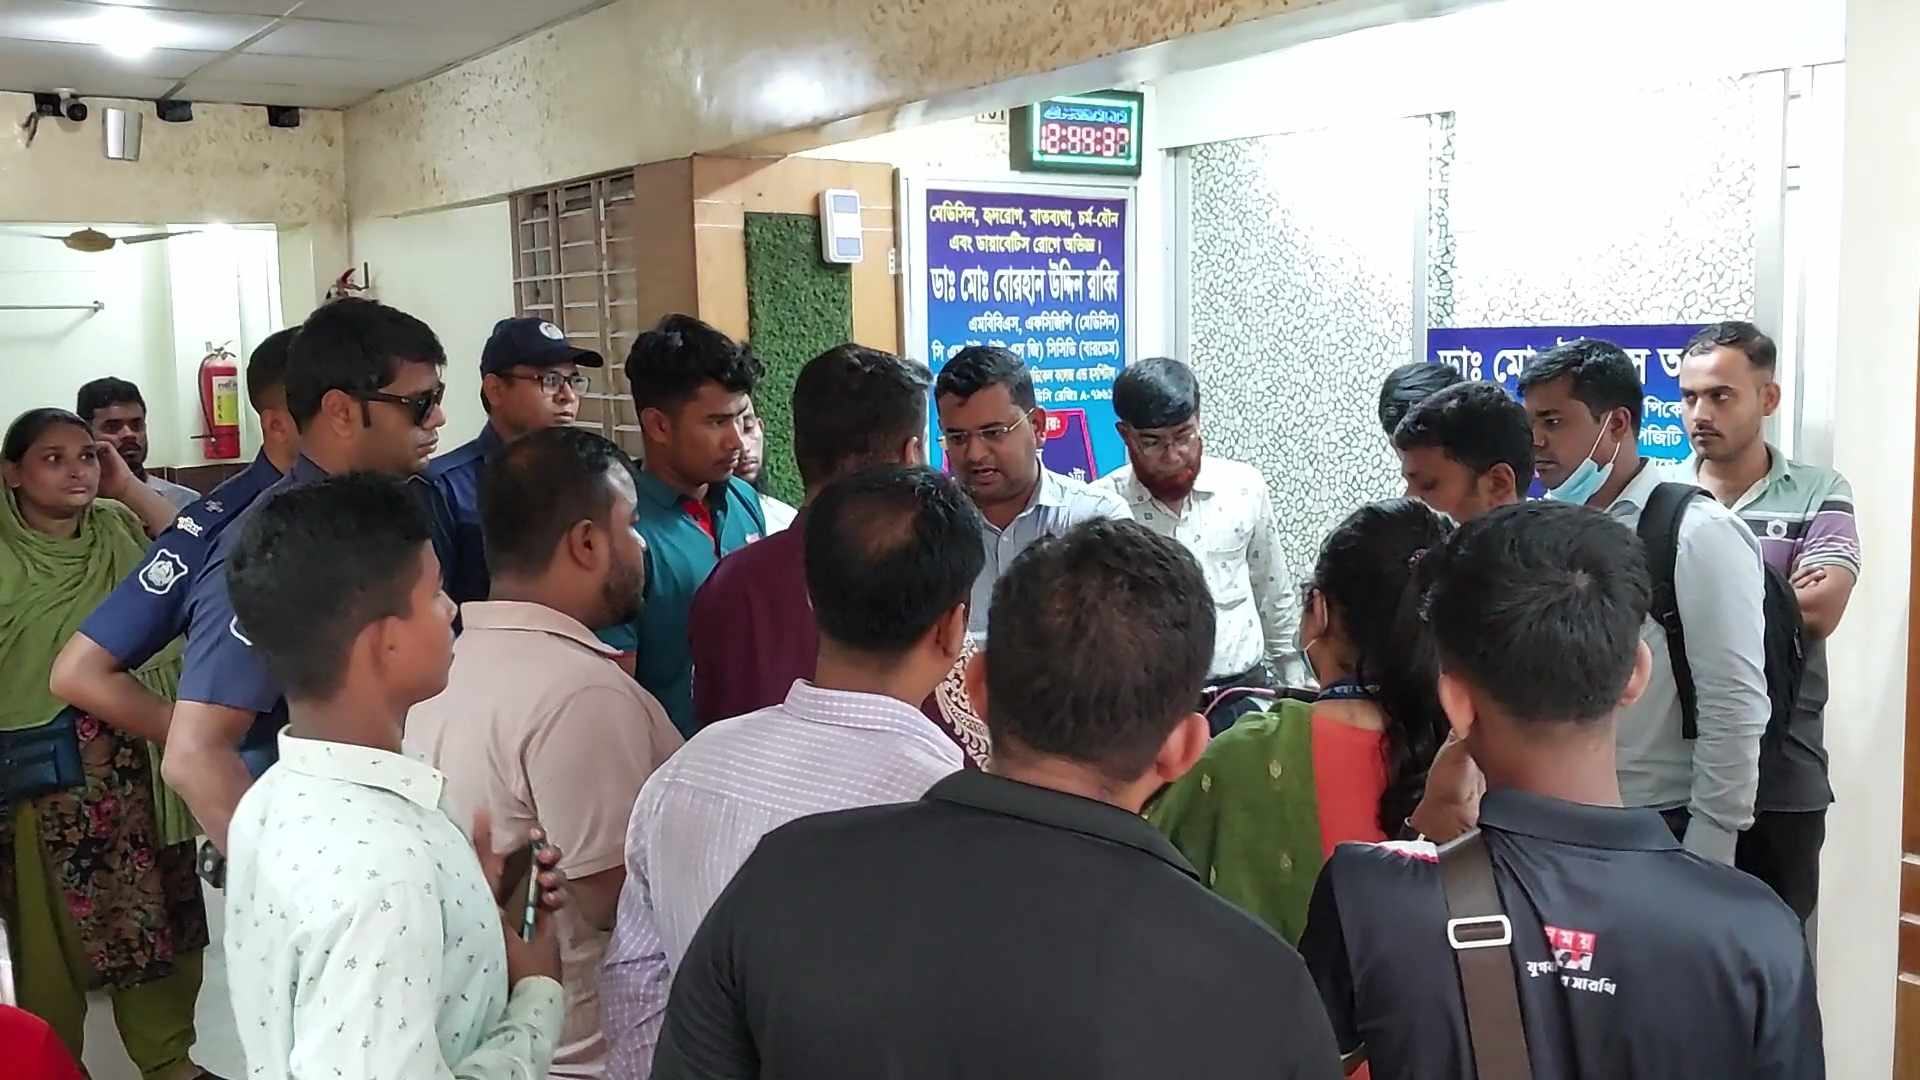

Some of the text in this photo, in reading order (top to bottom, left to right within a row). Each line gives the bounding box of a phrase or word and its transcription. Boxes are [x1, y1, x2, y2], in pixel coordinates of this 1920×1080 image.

[949, 234, 974, 253] এবং
[1033, 236, 1061, 254] রোগে
[929, 264, 956, 301] ডাঃ
[960, 264, 990, 303] মোঃ
[994, 265, 1046, 307] বোরহান
[1048, 257, 1085, 303] উদ্দিন
